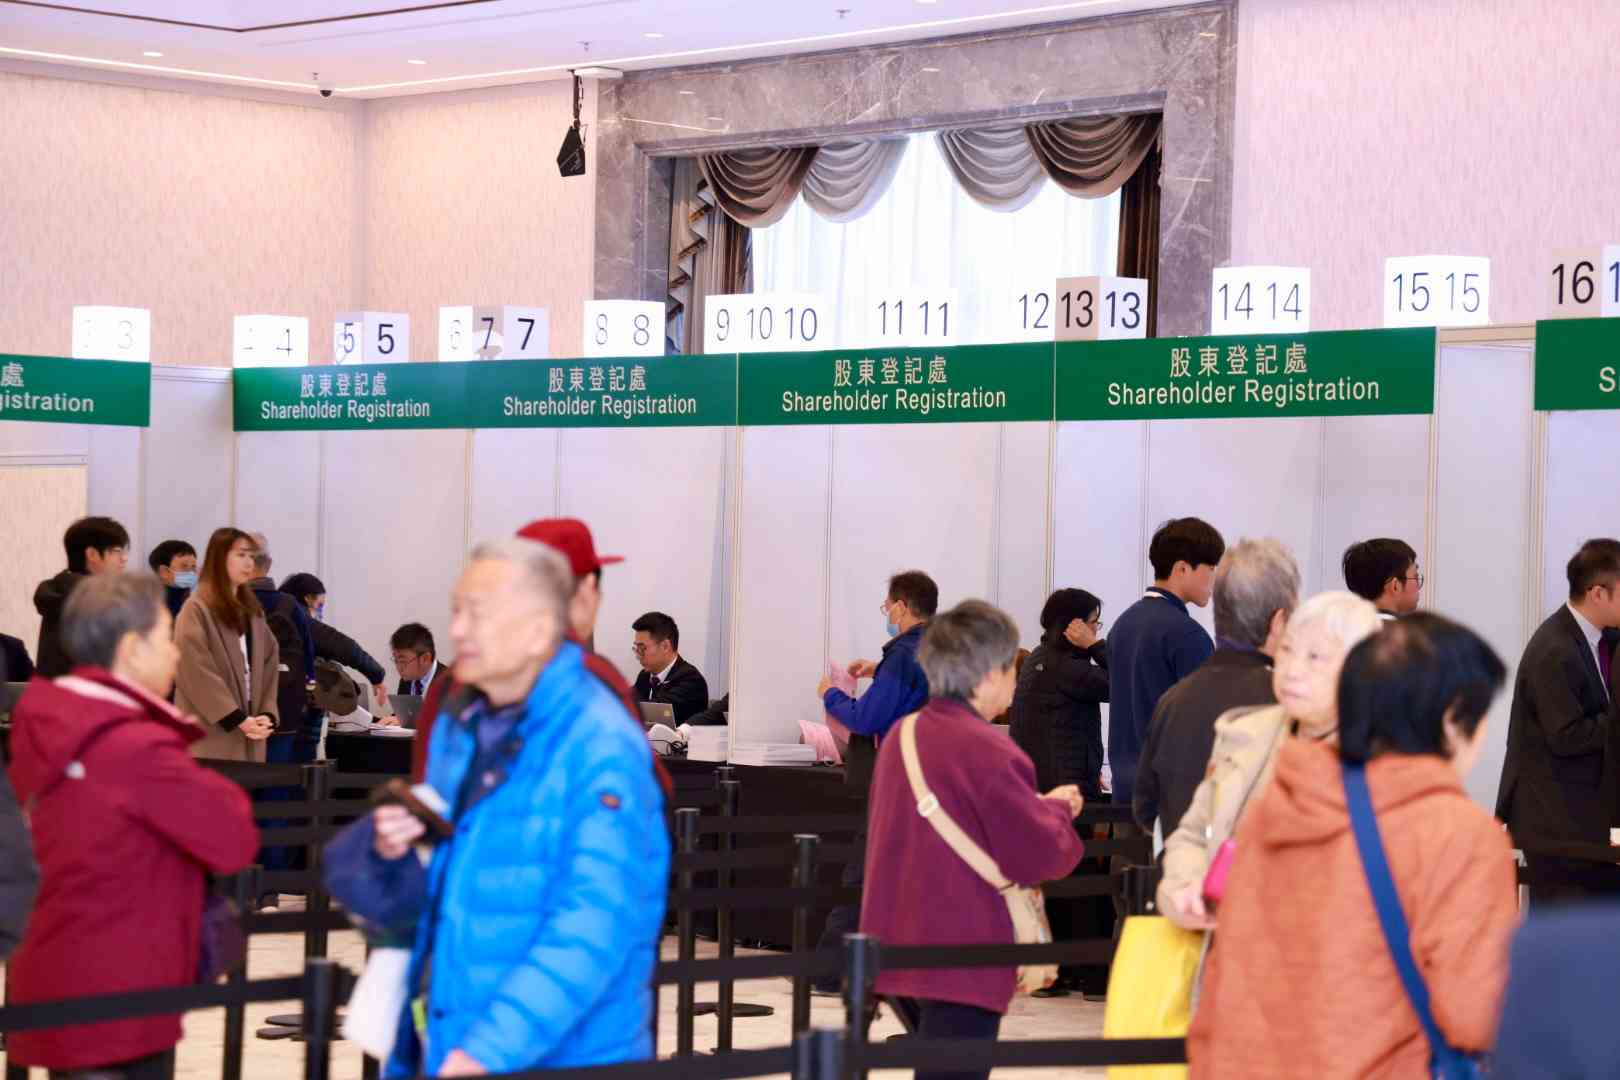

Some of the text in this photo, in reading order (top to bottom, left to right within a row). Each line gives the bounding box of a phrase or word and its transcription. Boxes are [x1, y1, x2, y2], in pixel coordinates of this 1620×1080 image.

[1392, 271, 1430, 313] 15
[1445, 271, 1480, 313] 15
[1553, 260, 1594, 305] 16
[1608, 261, 1620, 303] 1
[877, 298, 904, 336] 11
[1018, 291, 1050, 329] 12
[1060, 289, 1094, 329] 13
[1105, 290, 1141, 330] 13
[1218, 281, 1254, 321] 14
[1266, 281, 1302, 321] 14
[480, 317, 495, 349] 7
[517, 317, 536, 350] 7
[594, 313, 609, 346] 8
[632, 313, 651, 346] 8
[716, 308, 731, 342] 9
[745, 305, 773, 341] 10
[784, 305, 818, 342] 10
[919, 300, 949, 337] 11
[342, 321, 356, 354] 5
[377, 323, 396, 354] 5
[833, 355, 948, 387] 股東登記處
[1170, 343, 1308, 378] 股東登記處
[300, 372, 387, 398] 股東登記處
[548, 366, 648, 393] 股東登記處
[1108, 377, 1380, 407] Shareholder Registration
[1599, 366, 1620, 393] S
[261, 400, 430, 423] Shareholder Registration
[503, 394, 697, 419] Shareholder Registration
[782, 386, 1006, 415] Shareholder Registration
